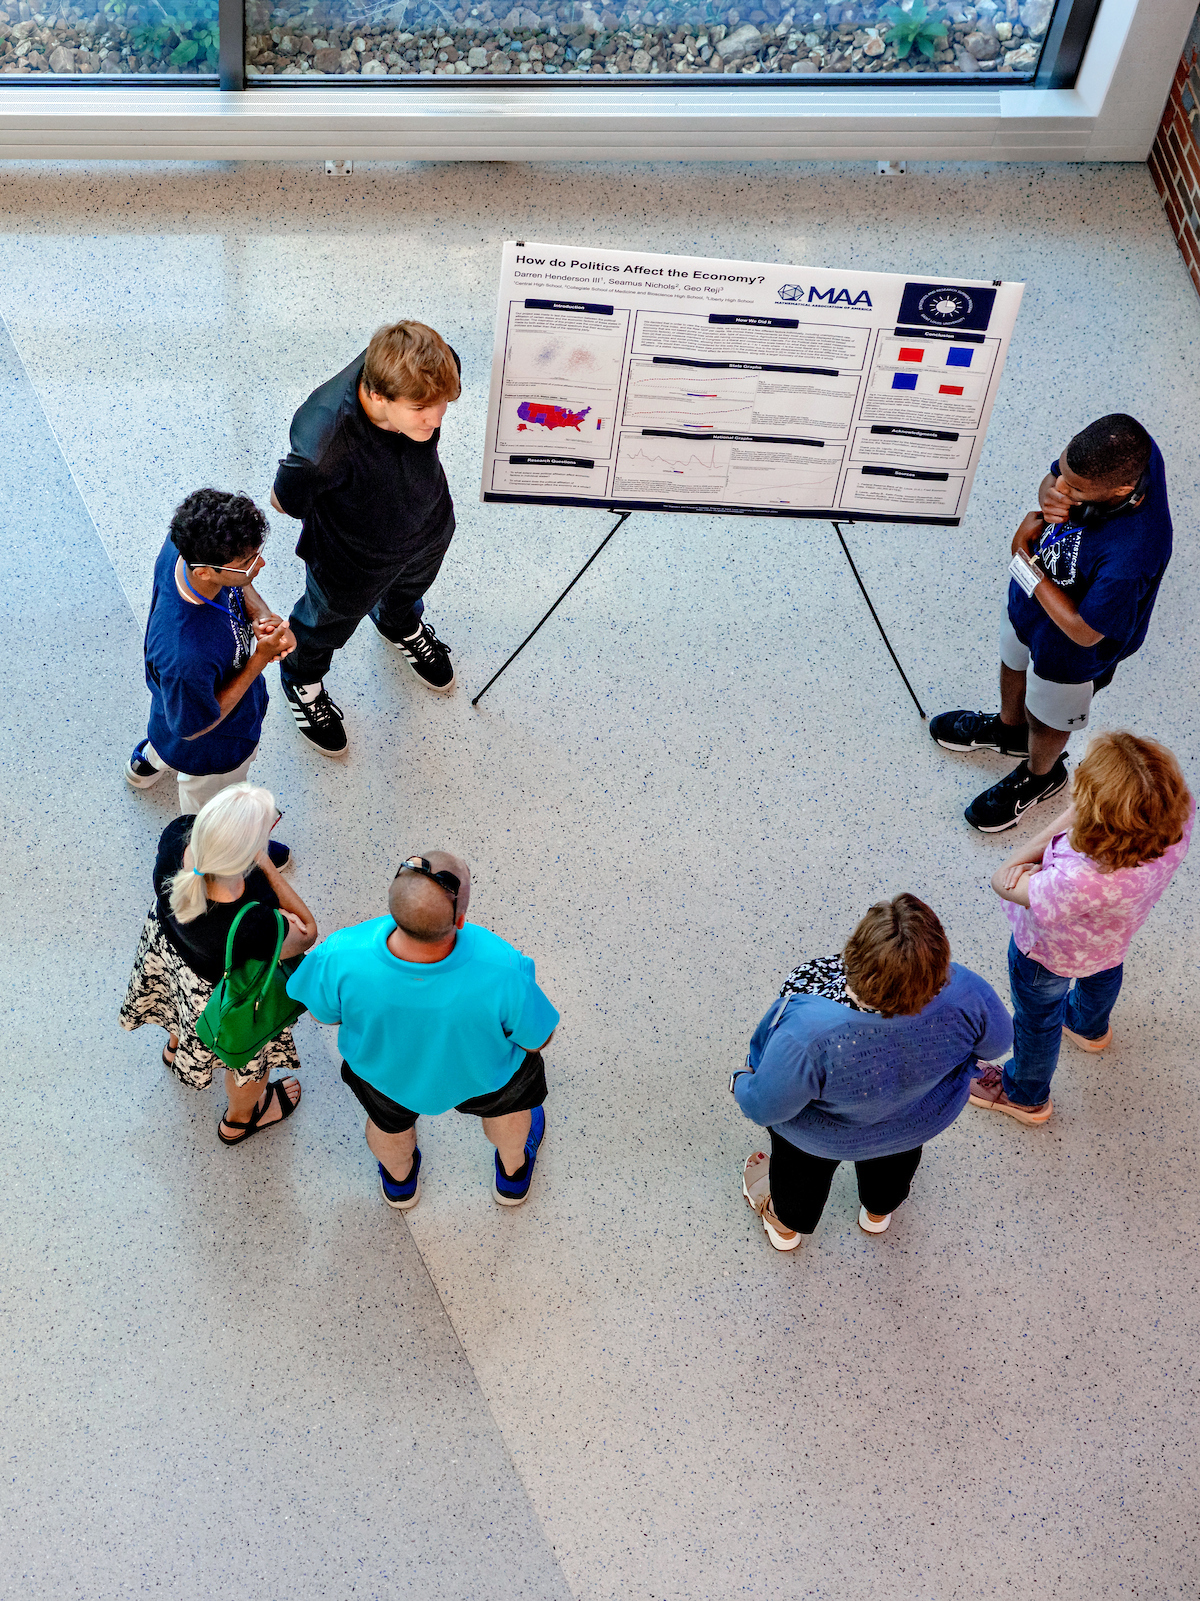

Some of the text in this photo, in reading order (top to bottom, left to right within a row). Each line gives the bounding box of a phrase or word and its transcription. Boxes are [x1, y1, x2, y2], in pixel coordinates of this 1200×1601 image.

[514, 271, 543, 279] Darren
[545, 273, 590, 283] Henderson
[608, 278, 643, 287] Seamus
[516, 255, 765, 285] How do Politics Affect the Economy?
[808, 286, 873, 307] MAA
[924, 331, 955, 339] Conclusion
[1070, 529, 1082, 566] TATISTICS
